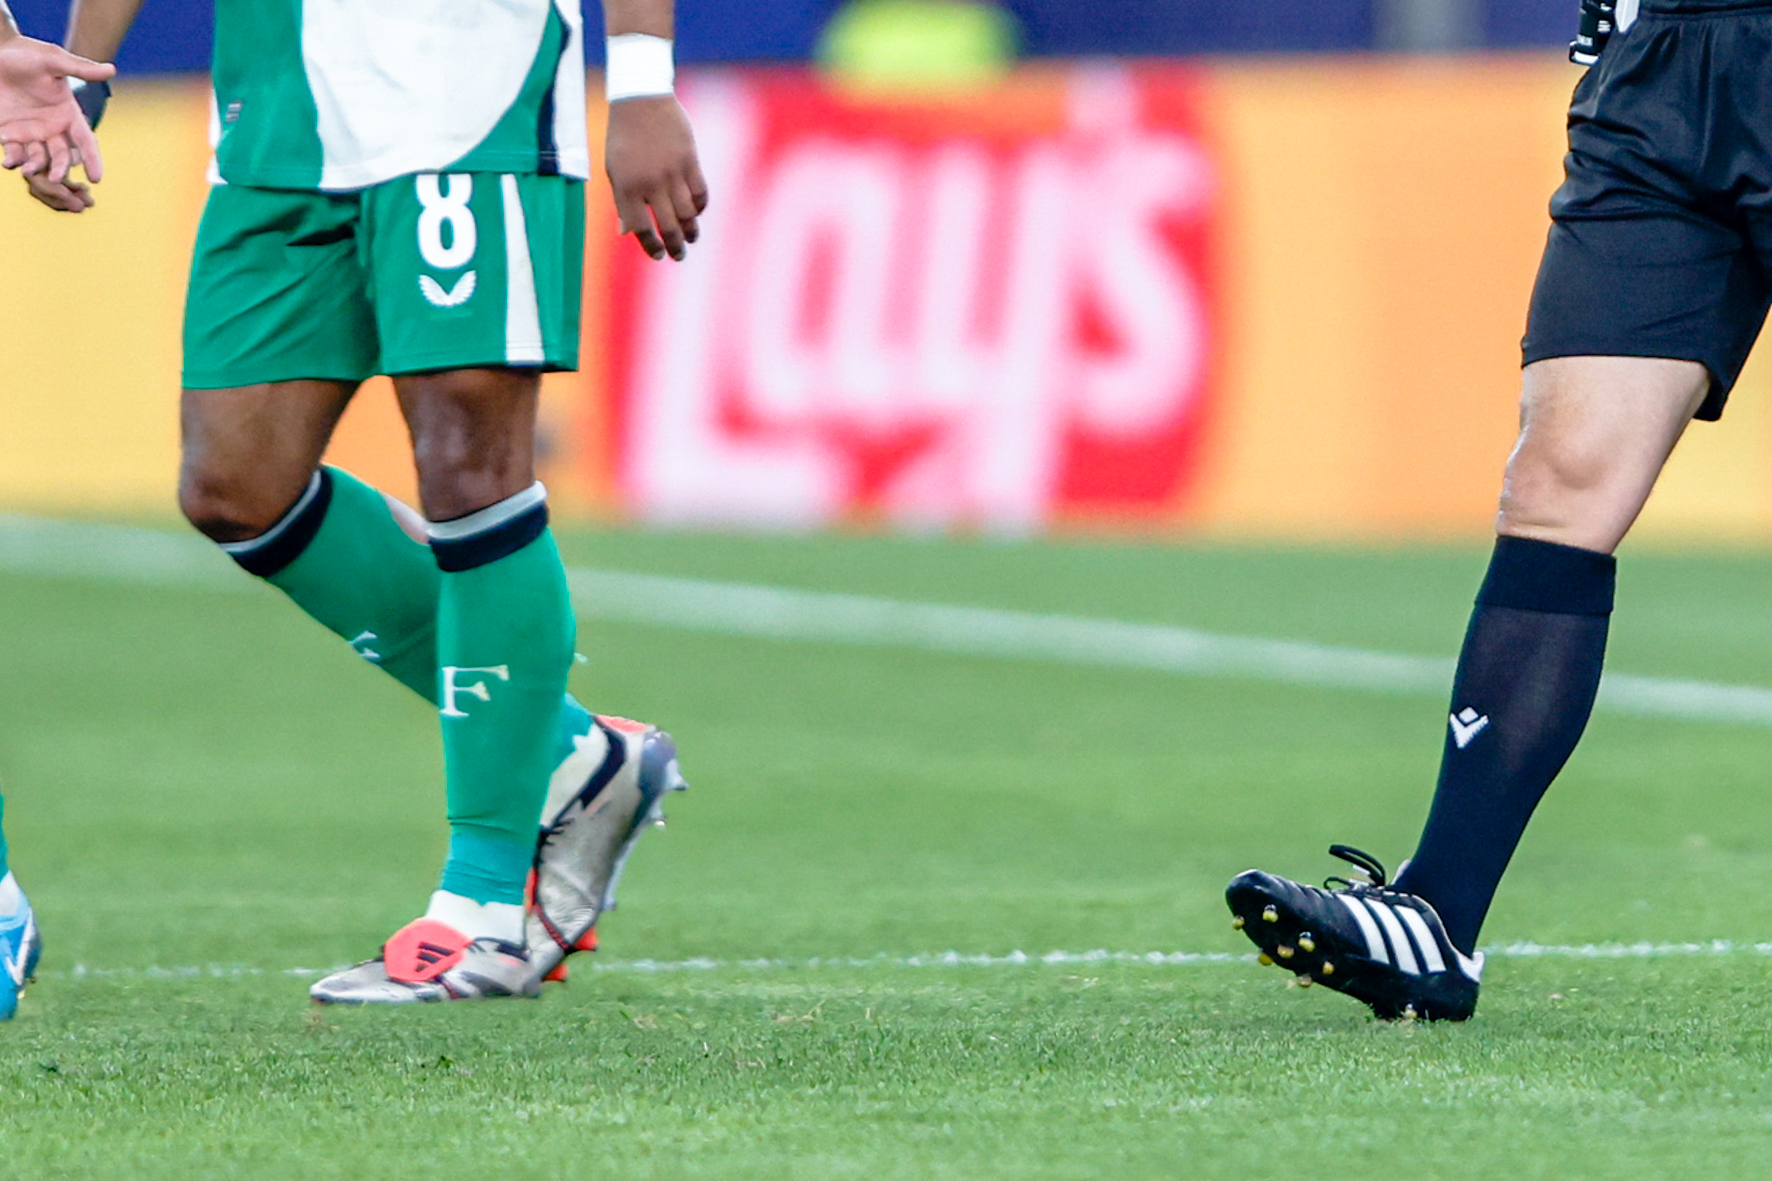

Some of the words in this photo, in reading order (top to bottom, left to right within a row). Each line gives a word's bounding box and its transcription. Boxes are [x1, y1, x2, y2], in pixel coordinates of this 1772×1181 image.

[415, 173, 478, 269] 8
[625, 65, 1216, 535] Lay's
[439, 664, 511, 717] F
